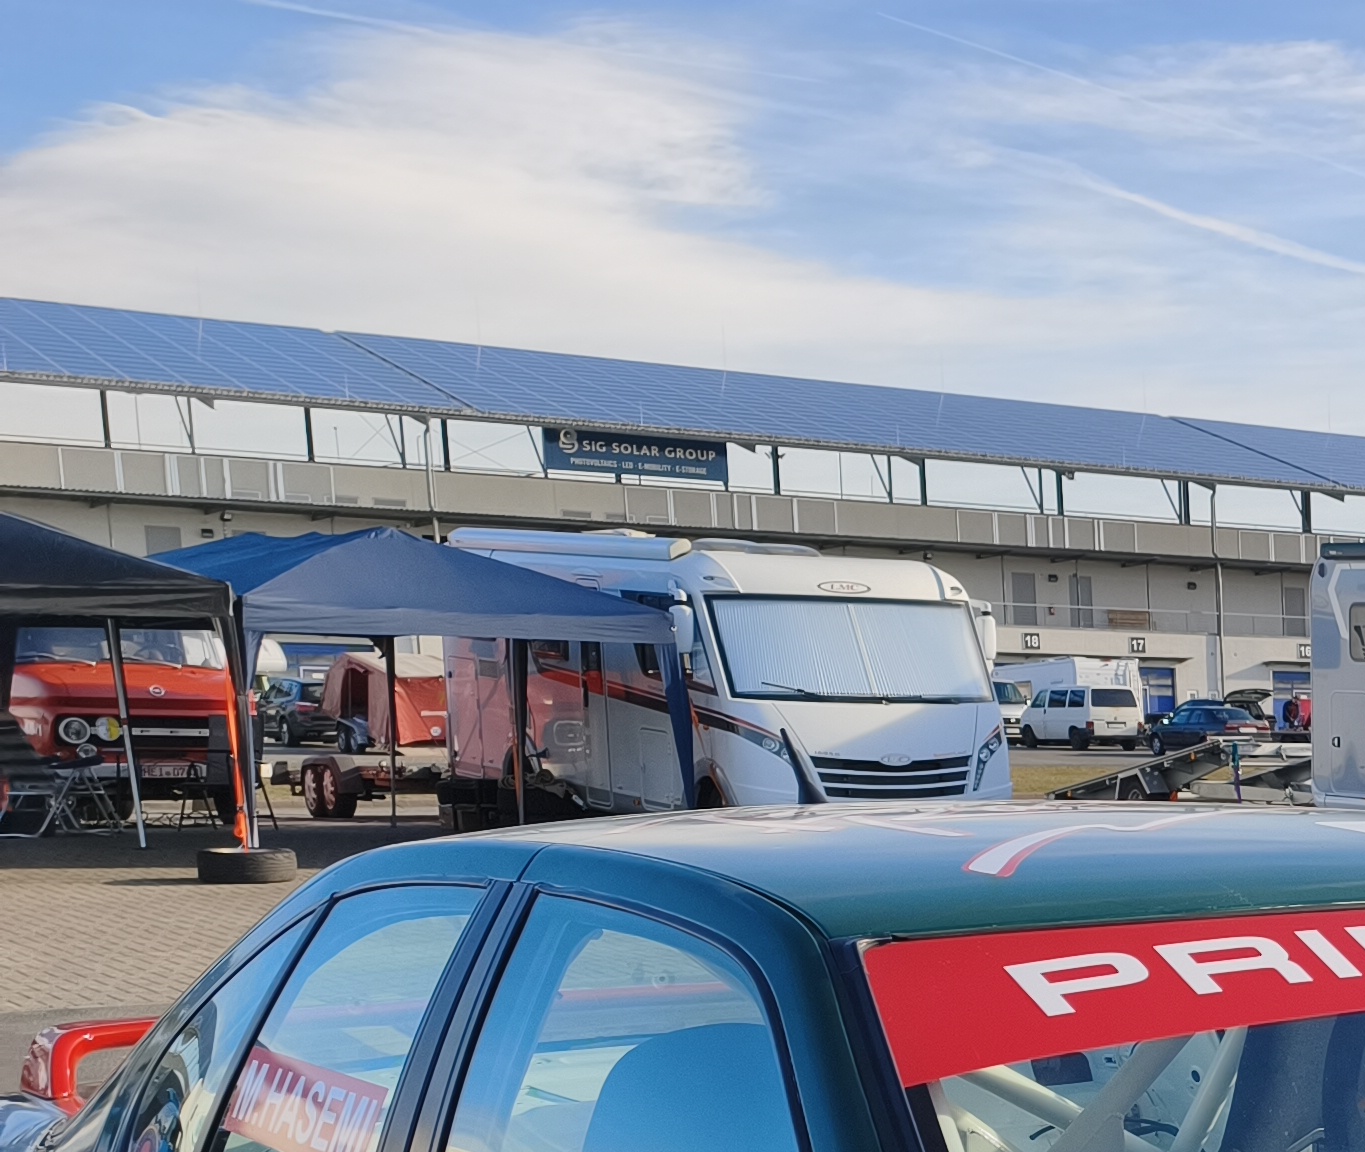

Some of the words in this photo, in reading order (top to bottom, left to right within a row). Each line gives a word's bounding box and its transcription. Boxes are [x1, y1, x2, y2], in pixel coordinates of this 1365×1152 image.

[582, 440, 606, 453] SIG
[611, 442, 660, 457] SOLAR
[664, 447, 716, 462] GROUP
[1023, 635, 1040, 648] 18
[1131, 639, 1146, 651] 17
